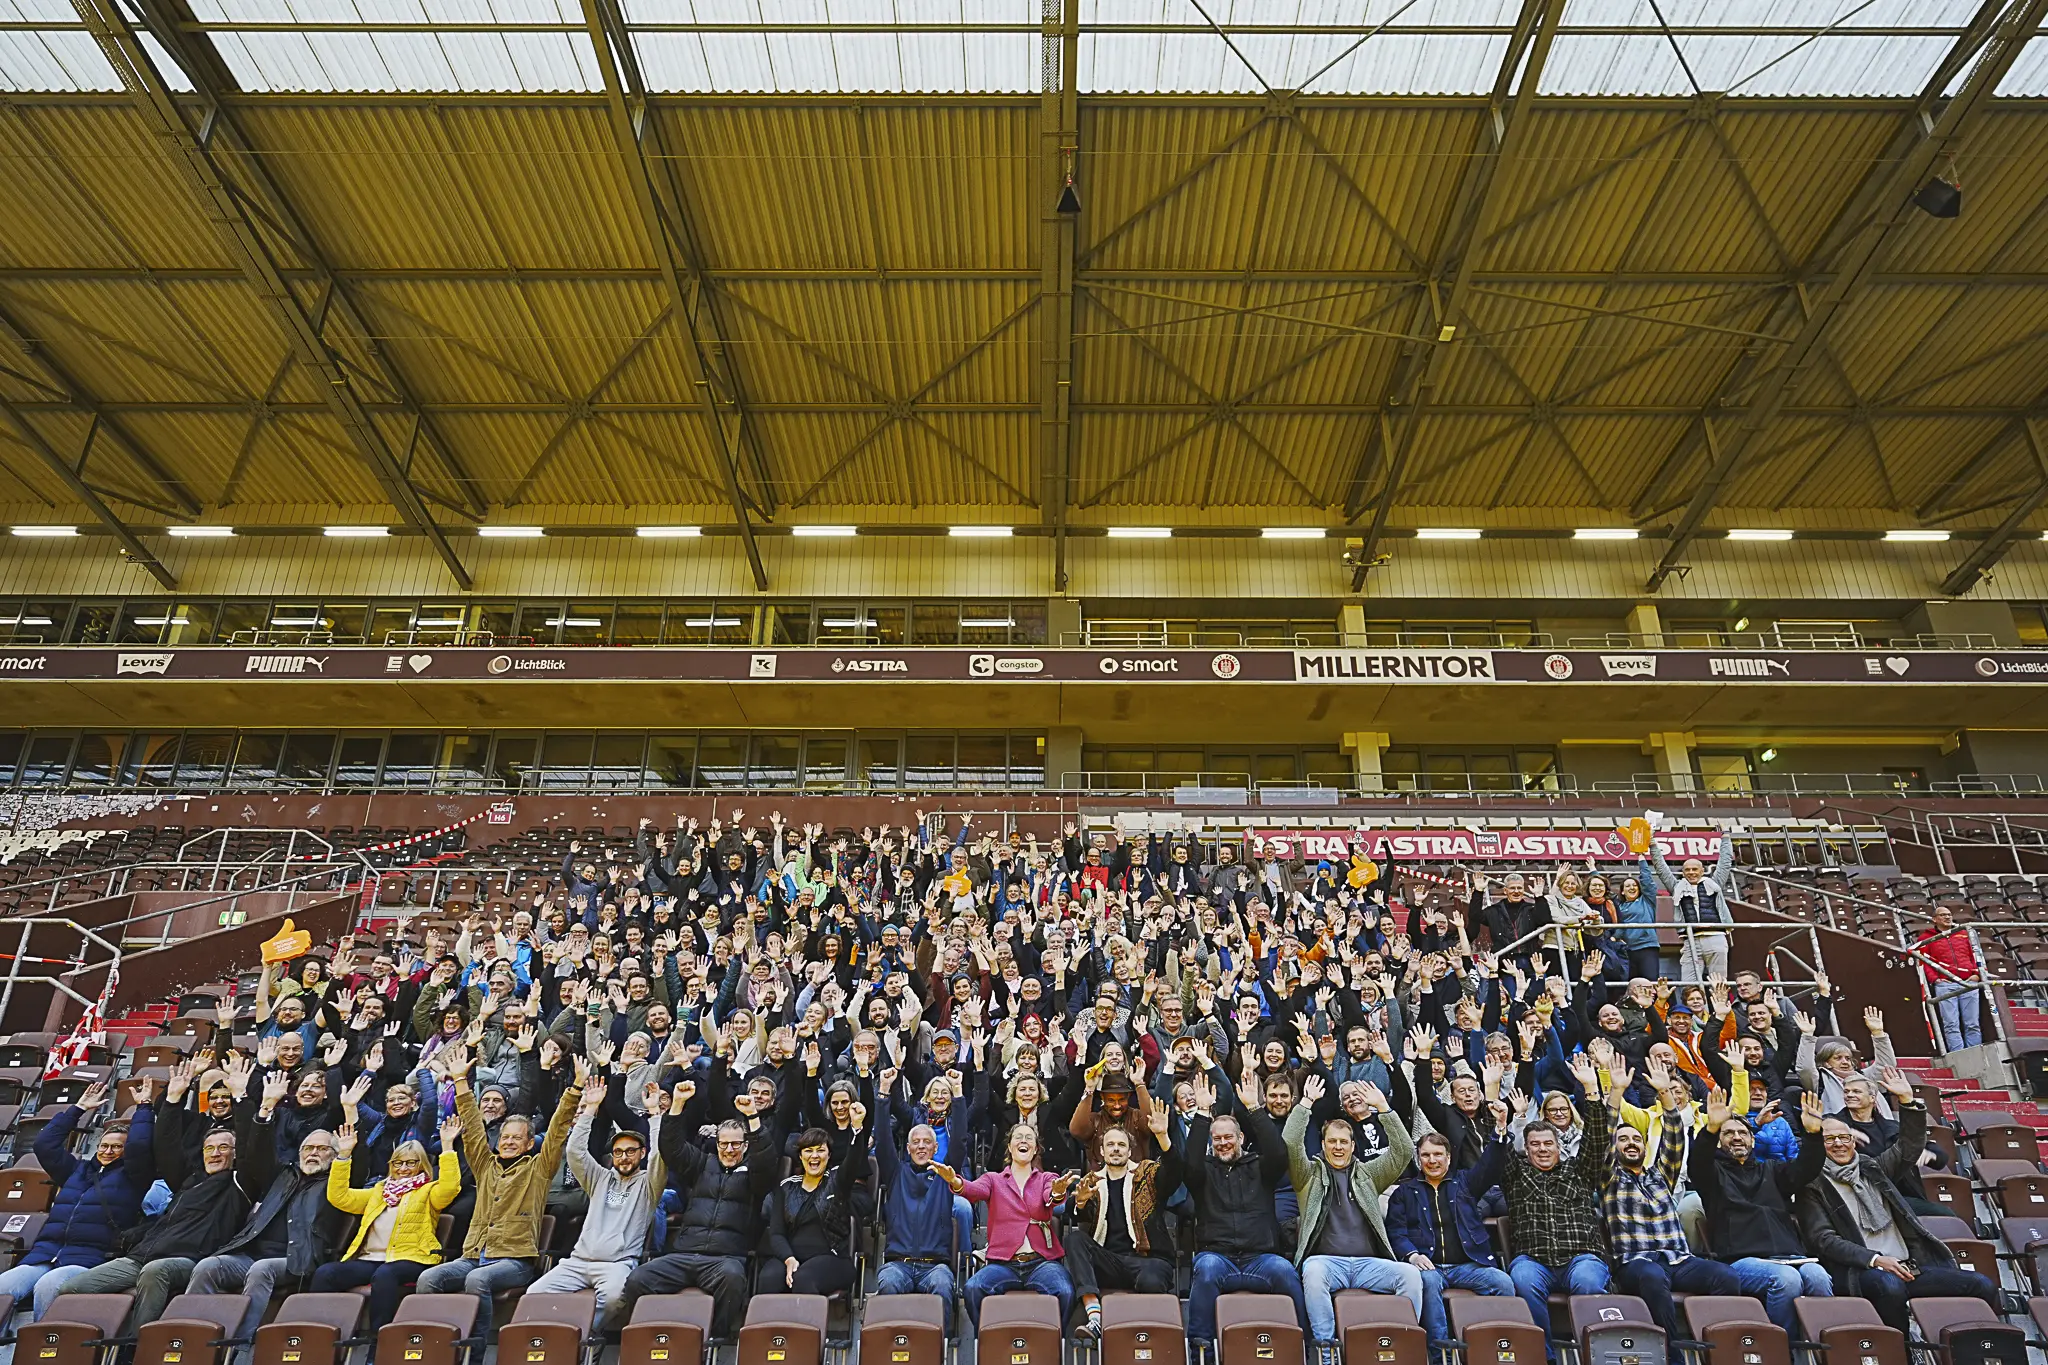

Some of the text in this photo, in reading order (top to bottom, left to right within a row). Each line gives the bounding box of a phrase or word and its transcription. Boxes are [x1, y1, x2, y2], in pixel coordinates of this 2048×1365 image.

[0, 656, 47, 670] mart
[245, 656, 305, 673] PUMA
[514, 659, 566, 670] LichtBlick
[755, 659, 771, 670] TK
[845, 660, 908, 671] ASTRA
[1000, 661, 1039, 671] congstar
[1122, 657, 1178, 672] smart
[1300, 656, 1491, 678] MILLERNTOR
[1709, 658, 1771, 676] PUMA
[494, 814, 506, 822] H6
[1373, 836, 1474, 855] ASTRA
[1476, 835, 1498, 843] Block
[1503, 836, 1605, 855] ASTRA
[1481, 845, 1496, 854] H5
[1630, 837, 1721, 856] STRA
